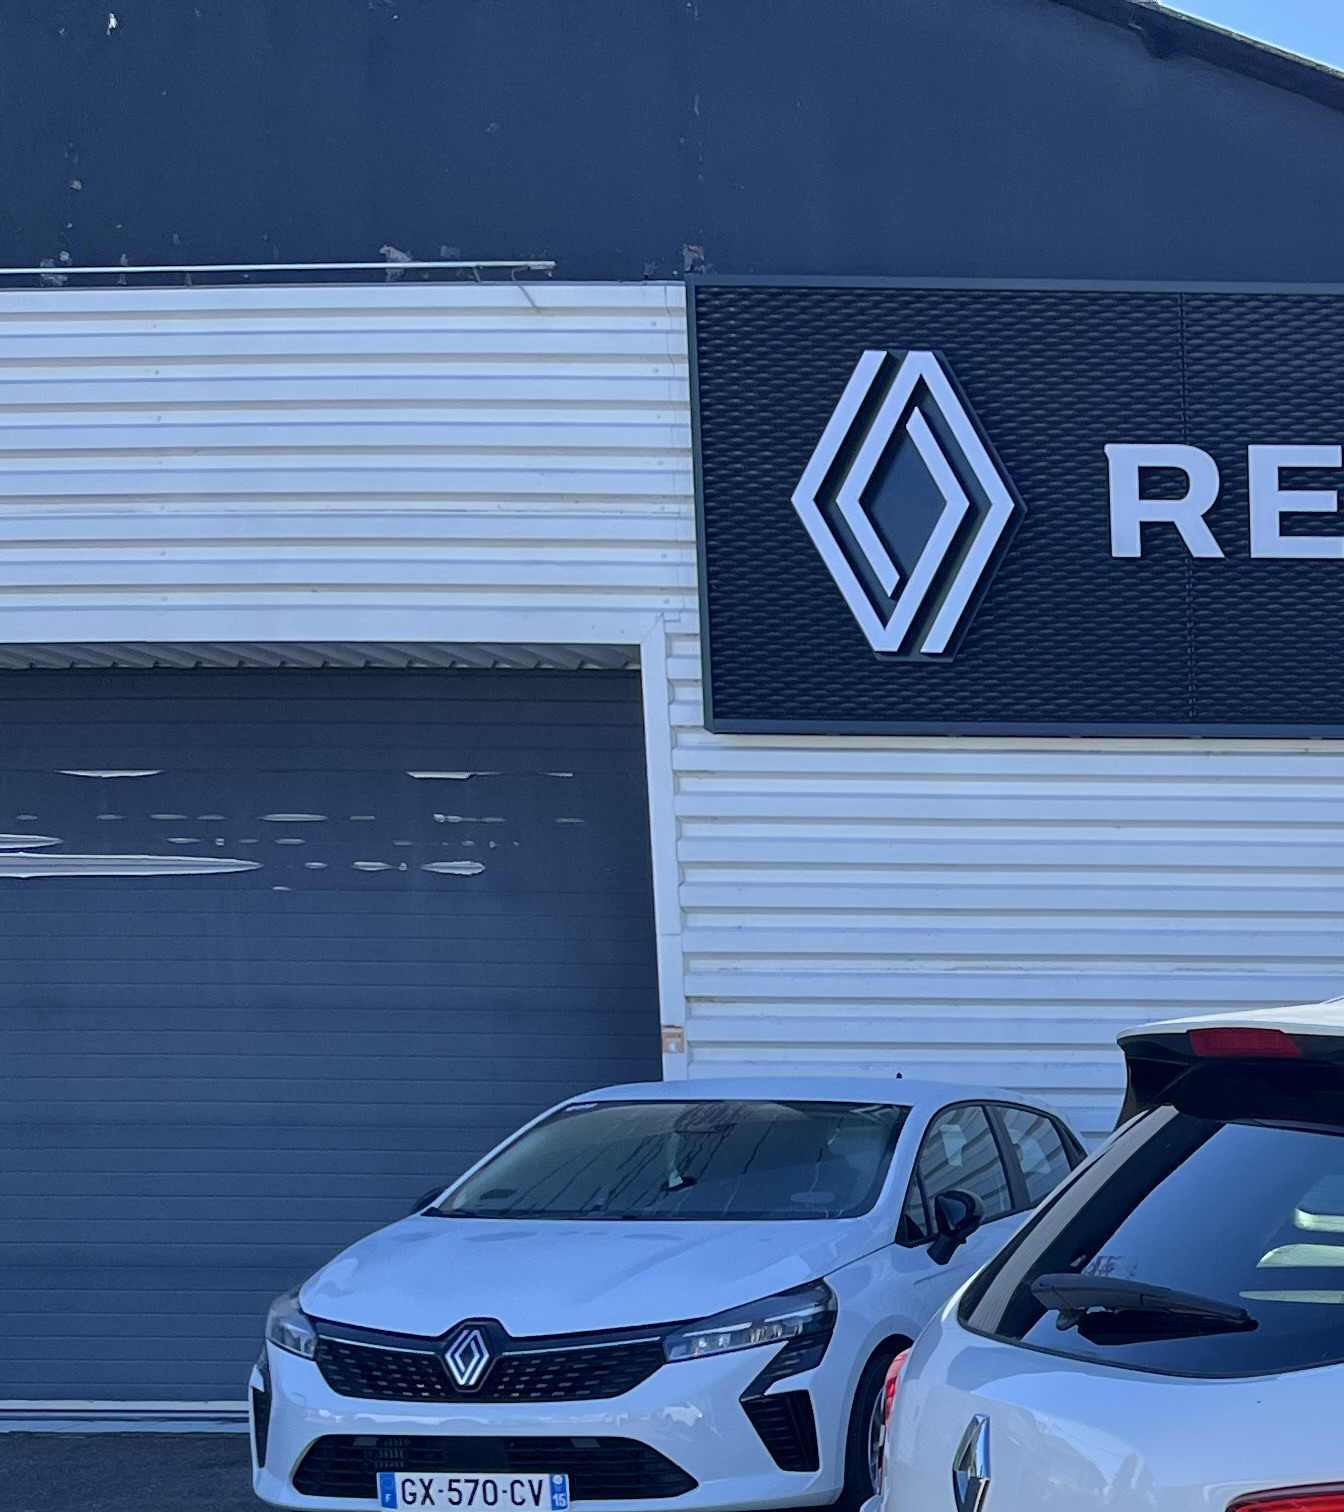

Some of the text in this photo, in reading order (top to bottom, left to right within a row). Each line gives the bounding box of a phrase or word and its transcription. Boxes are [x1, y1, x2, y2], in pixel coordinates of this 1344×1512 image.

[384, 1493, 392, 1503] F
[401, 1478, 543, 1507] GX-570-CV
[552, 1493, 567, 1508] 15
